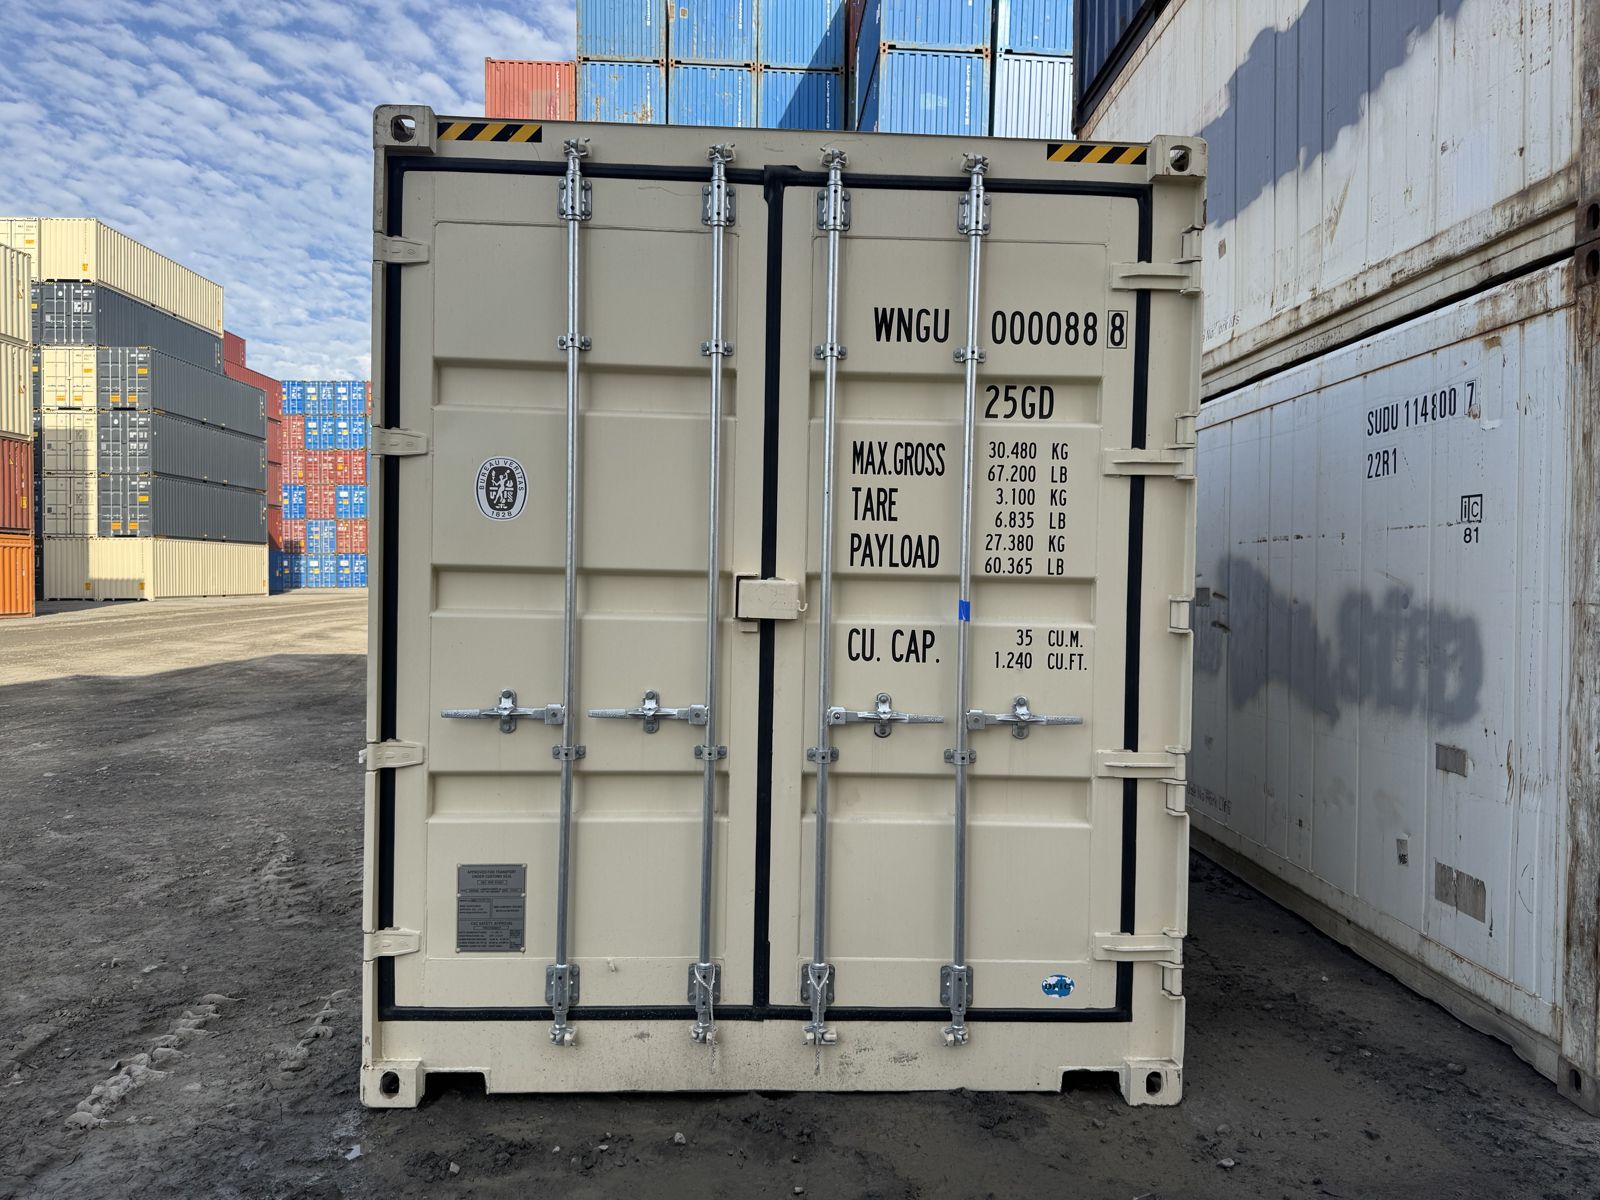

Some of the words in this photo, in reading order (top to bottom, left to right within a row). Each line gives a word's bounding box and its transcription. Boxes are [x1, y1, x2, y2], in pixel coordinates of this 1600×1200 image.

[873, 307, 950, 343] WNGU
[991, 310, 1098, 346] 000088
[1110, 312, 1125, 347] 8
[984, 384, 1055, 420] 25GD
[1367, 403, 1399, 437] SUDU
[852, 440, 946, 477] MAX.GROSS
[988, 441, 1037, 460] 30.480
[1051, 442, 1069, 461] KG
[1367, 447, 1397, 479] 22R1
[987, 464, 1036, 483] 67.200
[1050, 465, 1068, 484] LB
[851, 486, 899, 522] TARE
[995, 487, 1036, 506] 3.100
[1050, 488, 1067, 507] KG
[994, 511, 1035, 529] 6.835
[1049, 511, 1066, 530] LB
[985, 533, 1034, 552] 27.380
[1048, 534, 1065, 553] KG
[1463, 526, 1479, 544] 81
[849, 532, 940, 569] PAYLOAD
[984, 556, 1033, 575] 60.365
[1047, 557, 1064, 576] LB
[847, 627, 881, 662] CU.
[891, 628, 940, 664] CAP.
[1016, 628, 1033, 647] 35
[1047, 629, 1084, 648] CU.M.
[995, 651, 1033, 670] 1.240
[1047, 652, 1088, 671] CU.FT.
